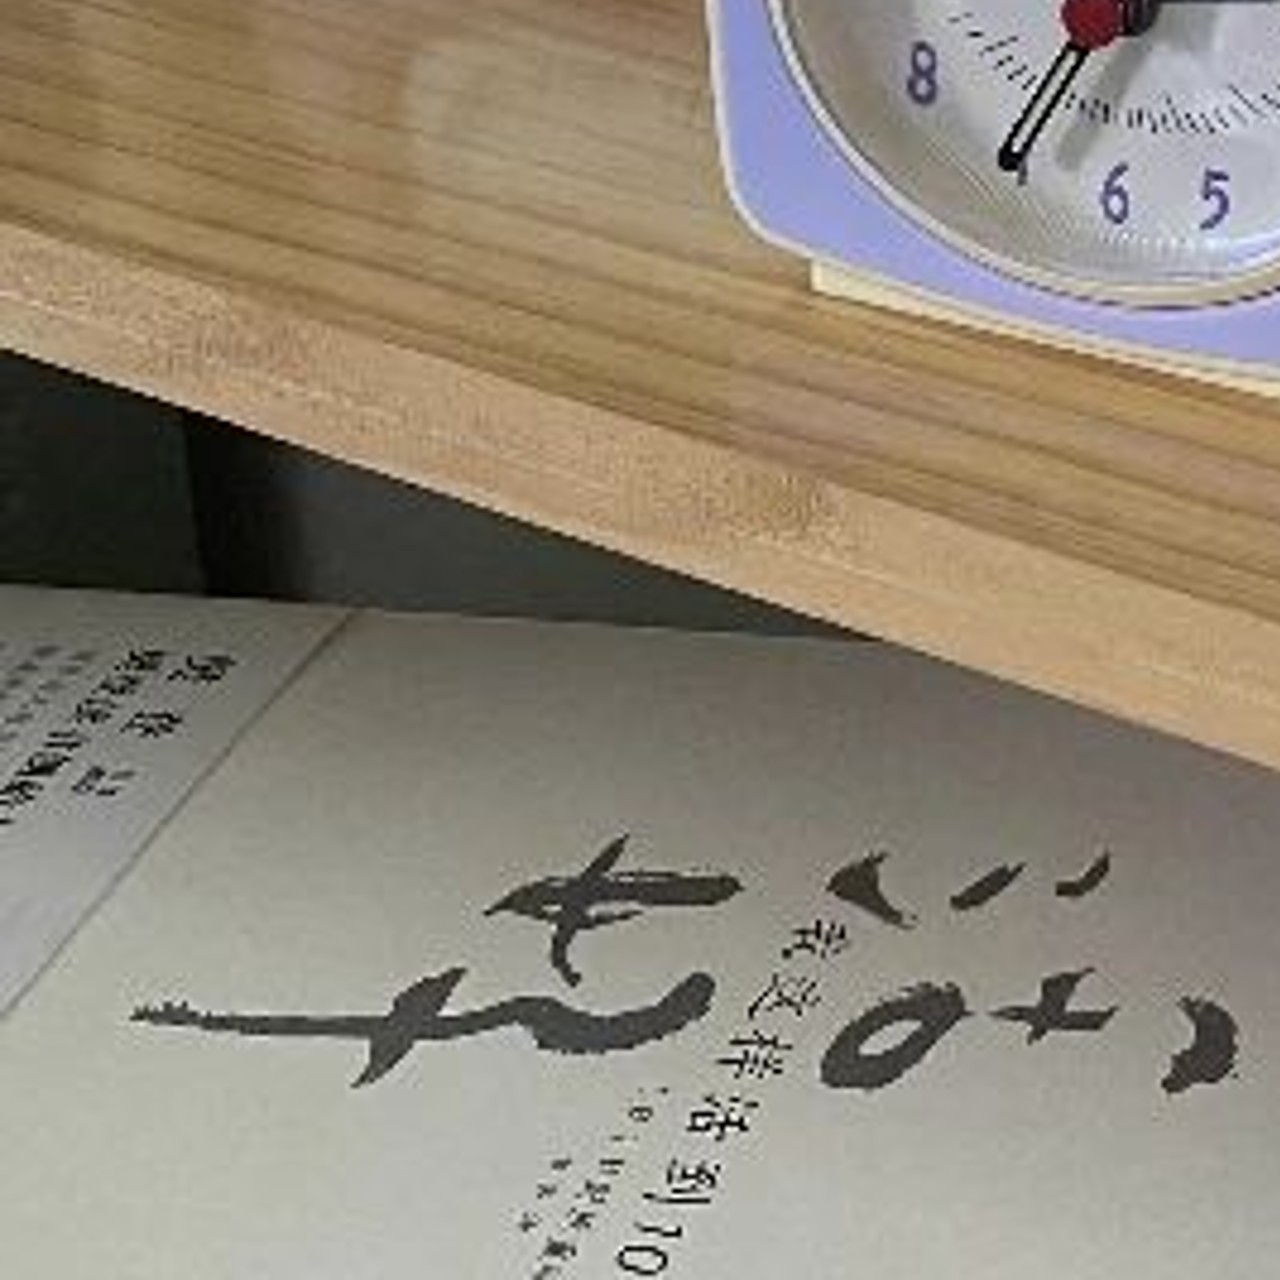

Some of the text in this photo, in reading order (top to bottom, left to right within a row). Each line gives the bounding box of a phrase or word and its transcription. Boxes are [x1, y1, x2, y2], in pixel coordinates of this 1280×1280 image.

[906, 40, 938, 106] 8
[1099, 161, 1131, 225] 6
[1199, 167, 1231, 231] 5
